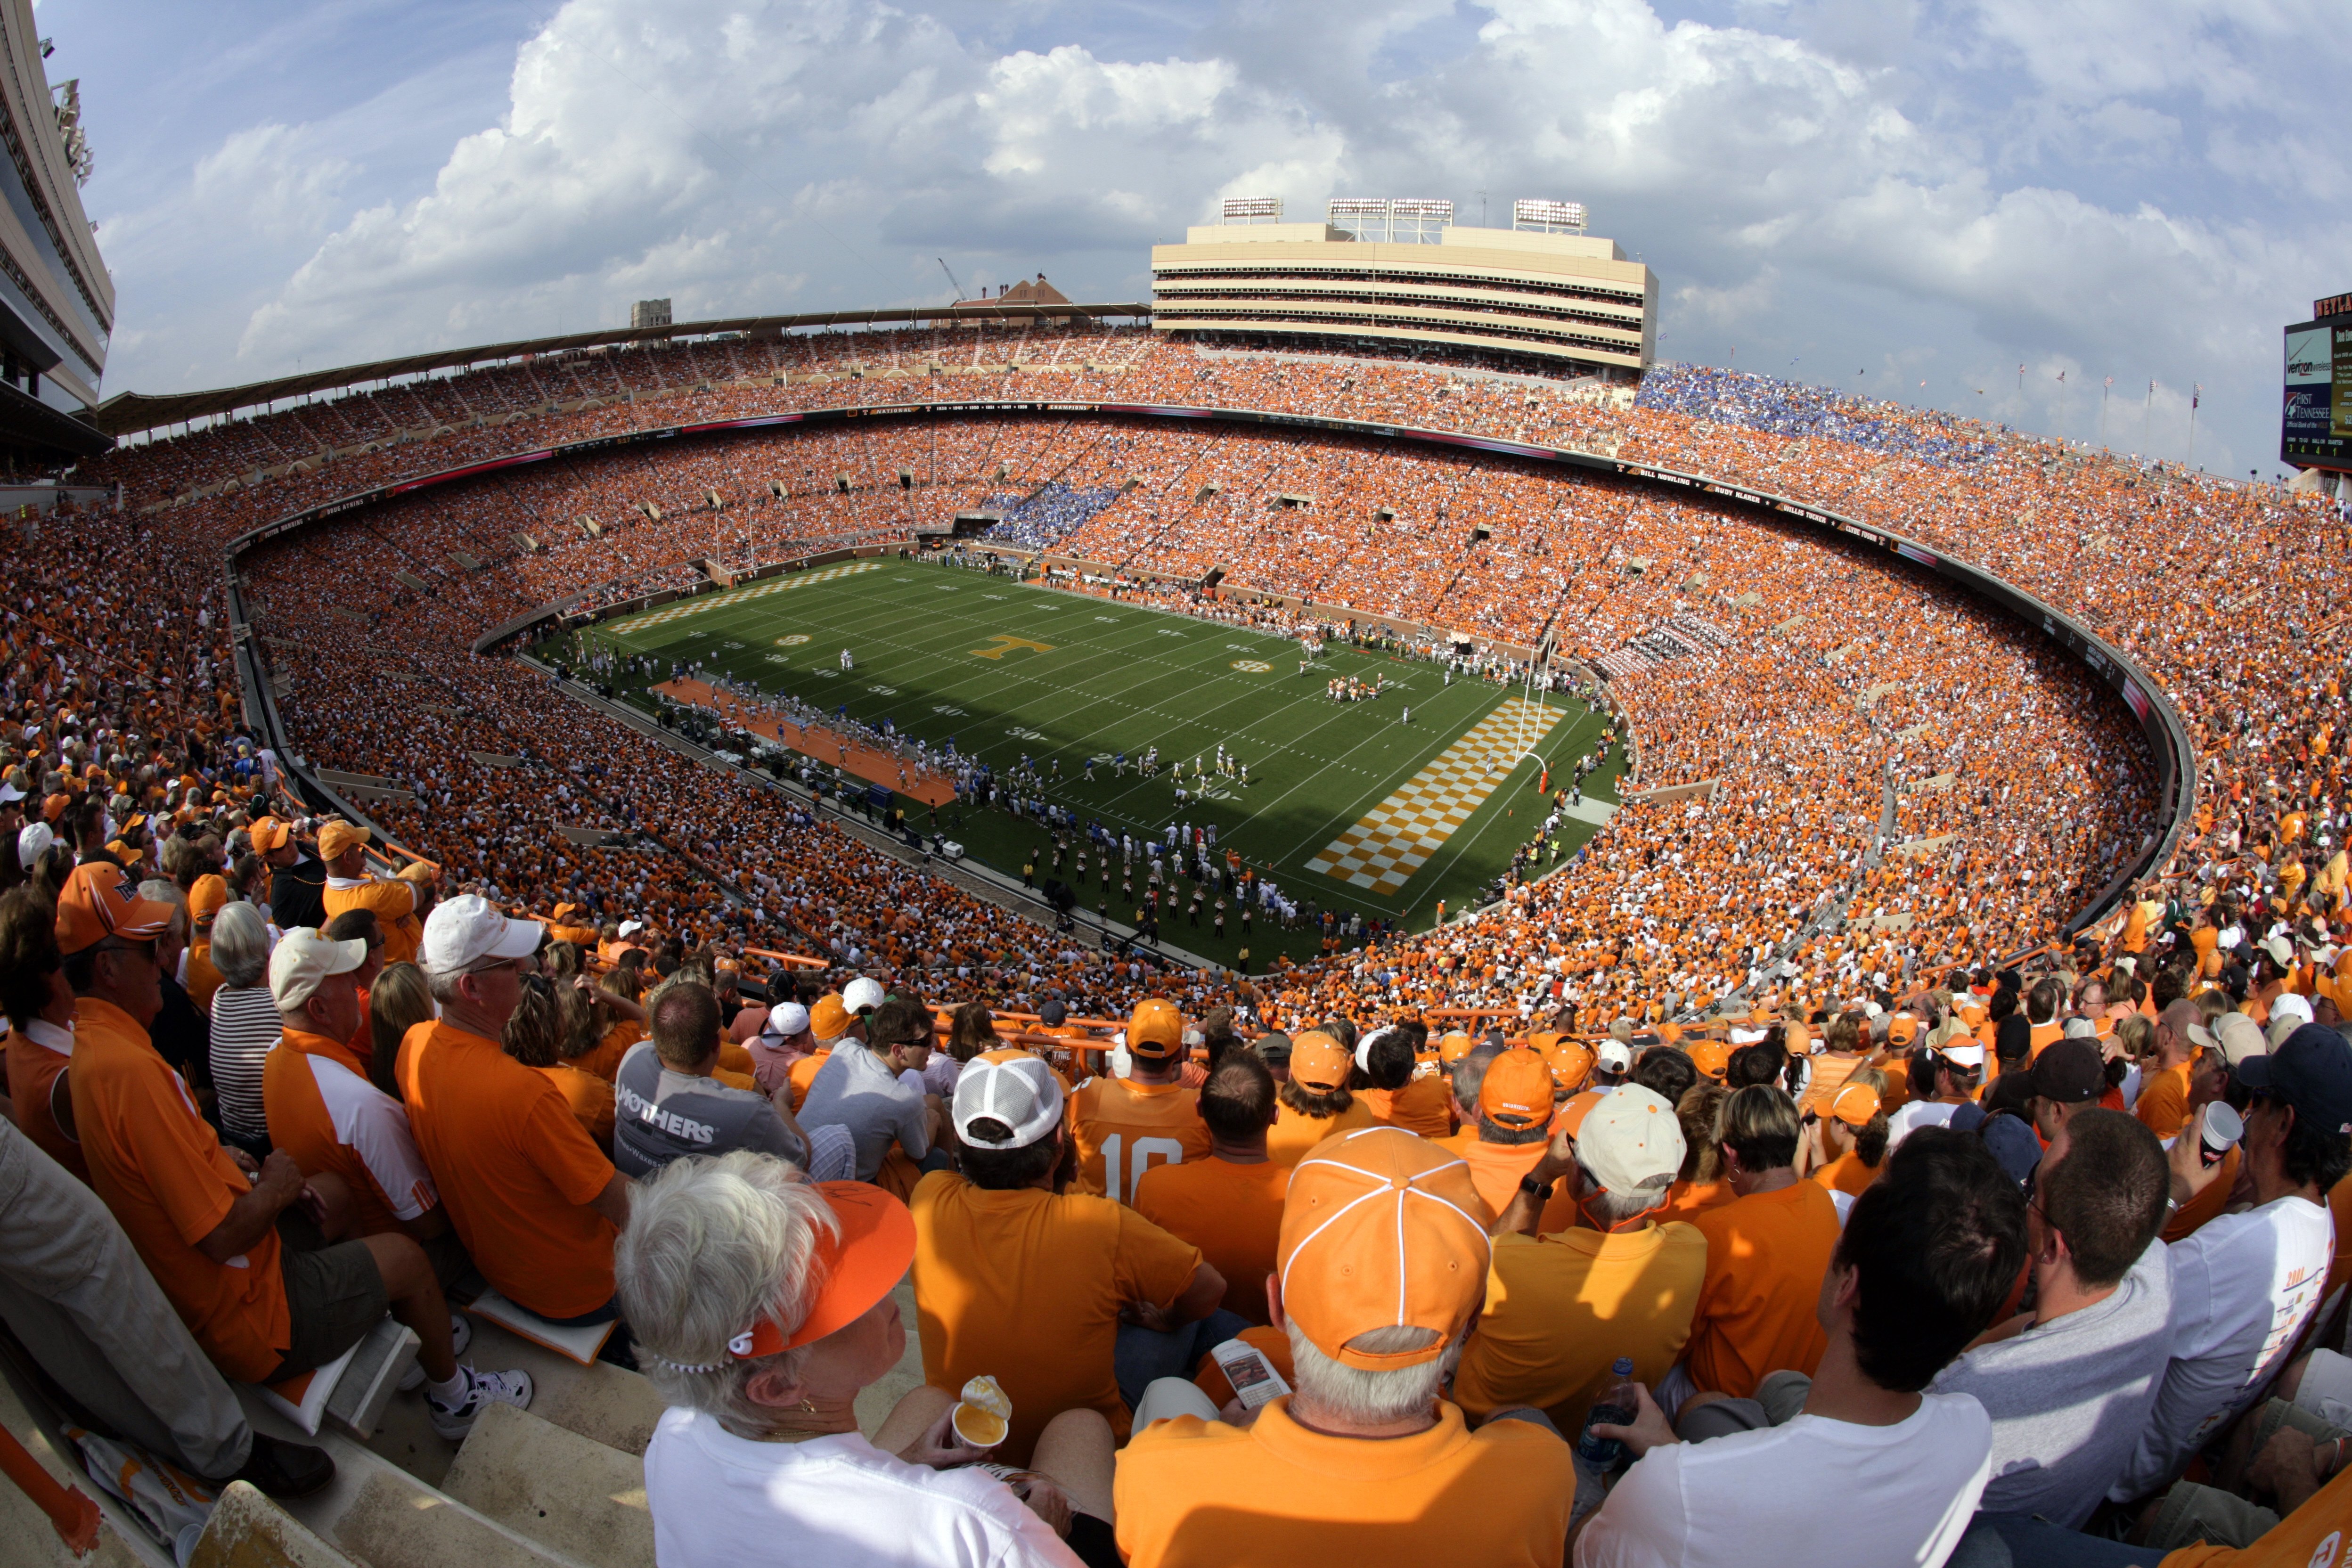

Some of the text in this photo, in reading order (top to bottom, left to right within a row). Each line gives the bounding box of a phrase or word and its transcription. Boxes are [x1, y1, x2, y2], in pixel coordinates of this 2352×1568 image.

[2297, 392, 2312, 405] FIRST
[2296, 406, 2329, 418] TENNESSEE
[1658, 473, 1690, 485] NOWLING
[1715, 487, 1733, 496] RUDY
[1735, 491, 1760, 503] KLARER
[327, 499, 364, 515] DOUG ATKINS
[1783, 505, 1826, 523] WILLIS TUCKER
[265, 518, 303, 539] PEYTON MANNING
[1846, 525, 1860, 536] CLYDE
[1233, 661, 1270, 672] SEC
[867, 685, 897, 695] 50
[932, 705, 964, 716] 40
[1004, 727, 1040, 740] 30
[1053, 1051, 1071, 1061] TIME
[618, 1082, 714, 1144] MOTHERS
[632, 1148, 657, 1168] Waxes
